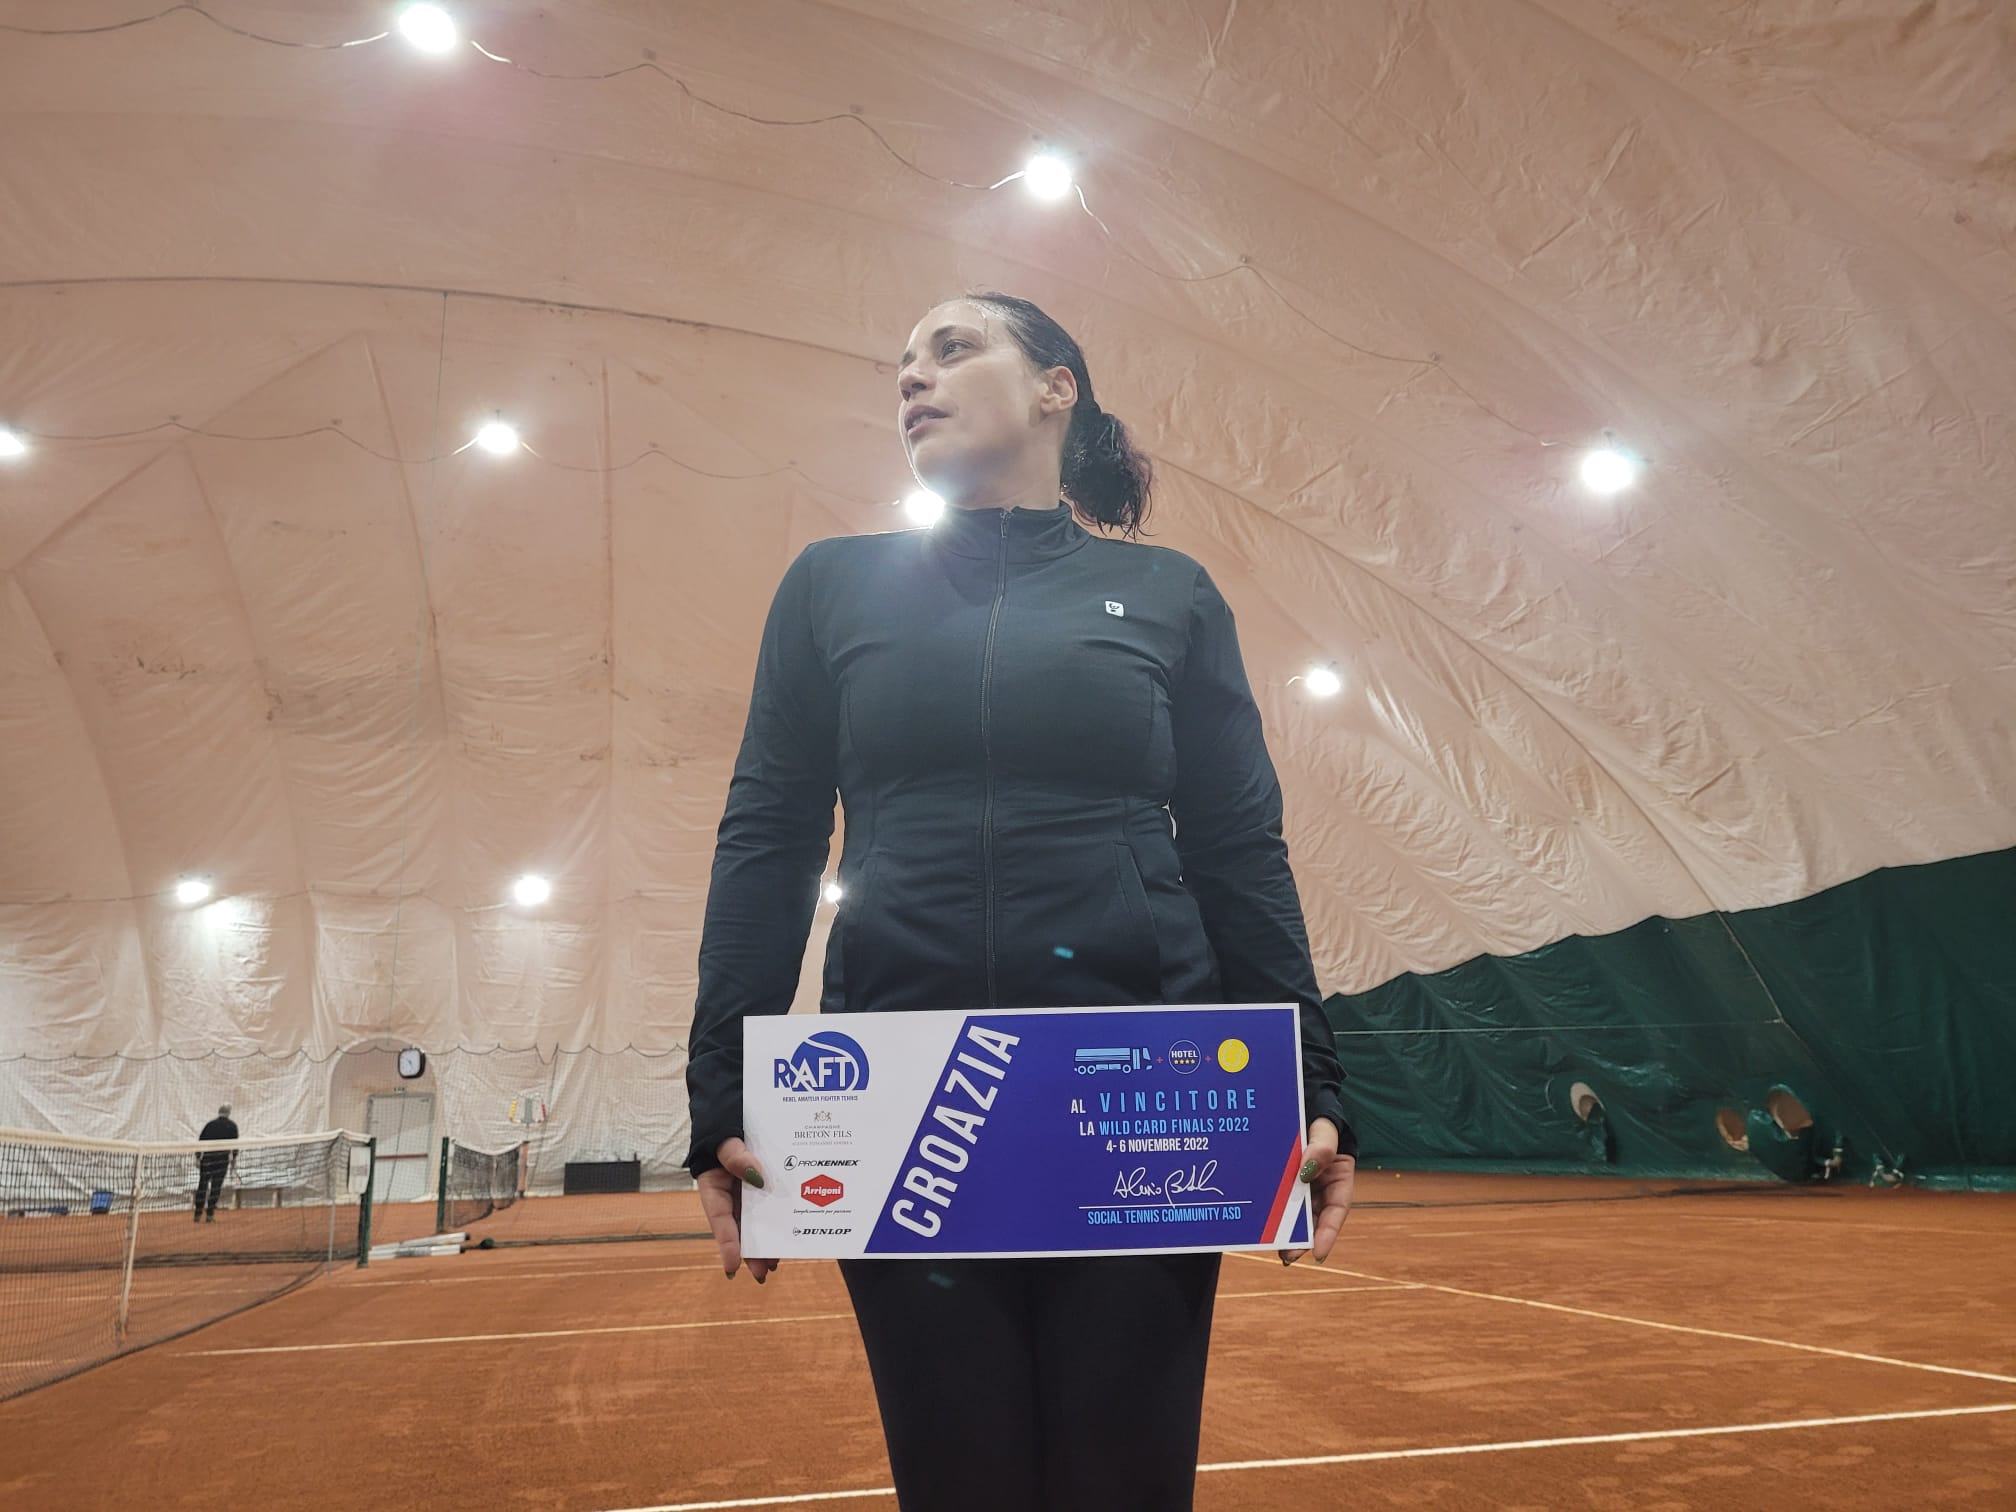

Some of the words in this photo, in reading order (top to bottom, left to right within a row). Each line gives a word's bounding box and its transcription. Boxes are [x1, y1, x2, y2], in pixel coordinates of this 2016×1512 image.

[1171, 1050, 1198, 1058] HOTEL
[1070, 1099, 1087, 1114] AL
[1100, 1089, 1256, 1113] VINCITORE
[794, 1130, 830, 1138] BRETON
[833, 1130, 852, 1138] FILS
[892, 1025, 1020, 1238] CROAZIA
[1079, 1121, 1095, 1136] LA
[1099, 1120, 1130, 1136] WILD
[1134, 1119, 1167, 1134] CARD
[1171, 1118, 1214, 1134] FINALS
[1218, 1117, 1250, 1132] 2022
[1128, 1138, 1181, 1152] NOVEMBRE
[1183, 1137, 1209, 1150] 2022
[803, 1186, 841, 1196] Arrigoni
[1087, 1210, 1123, 1224] SOCIAL
[1124, 1209, 1160, 1223] TENNIS
[1161, 1207, 1220, 1222] COMMUNITY
[1222, 1206, 1241, 1220] ASD
